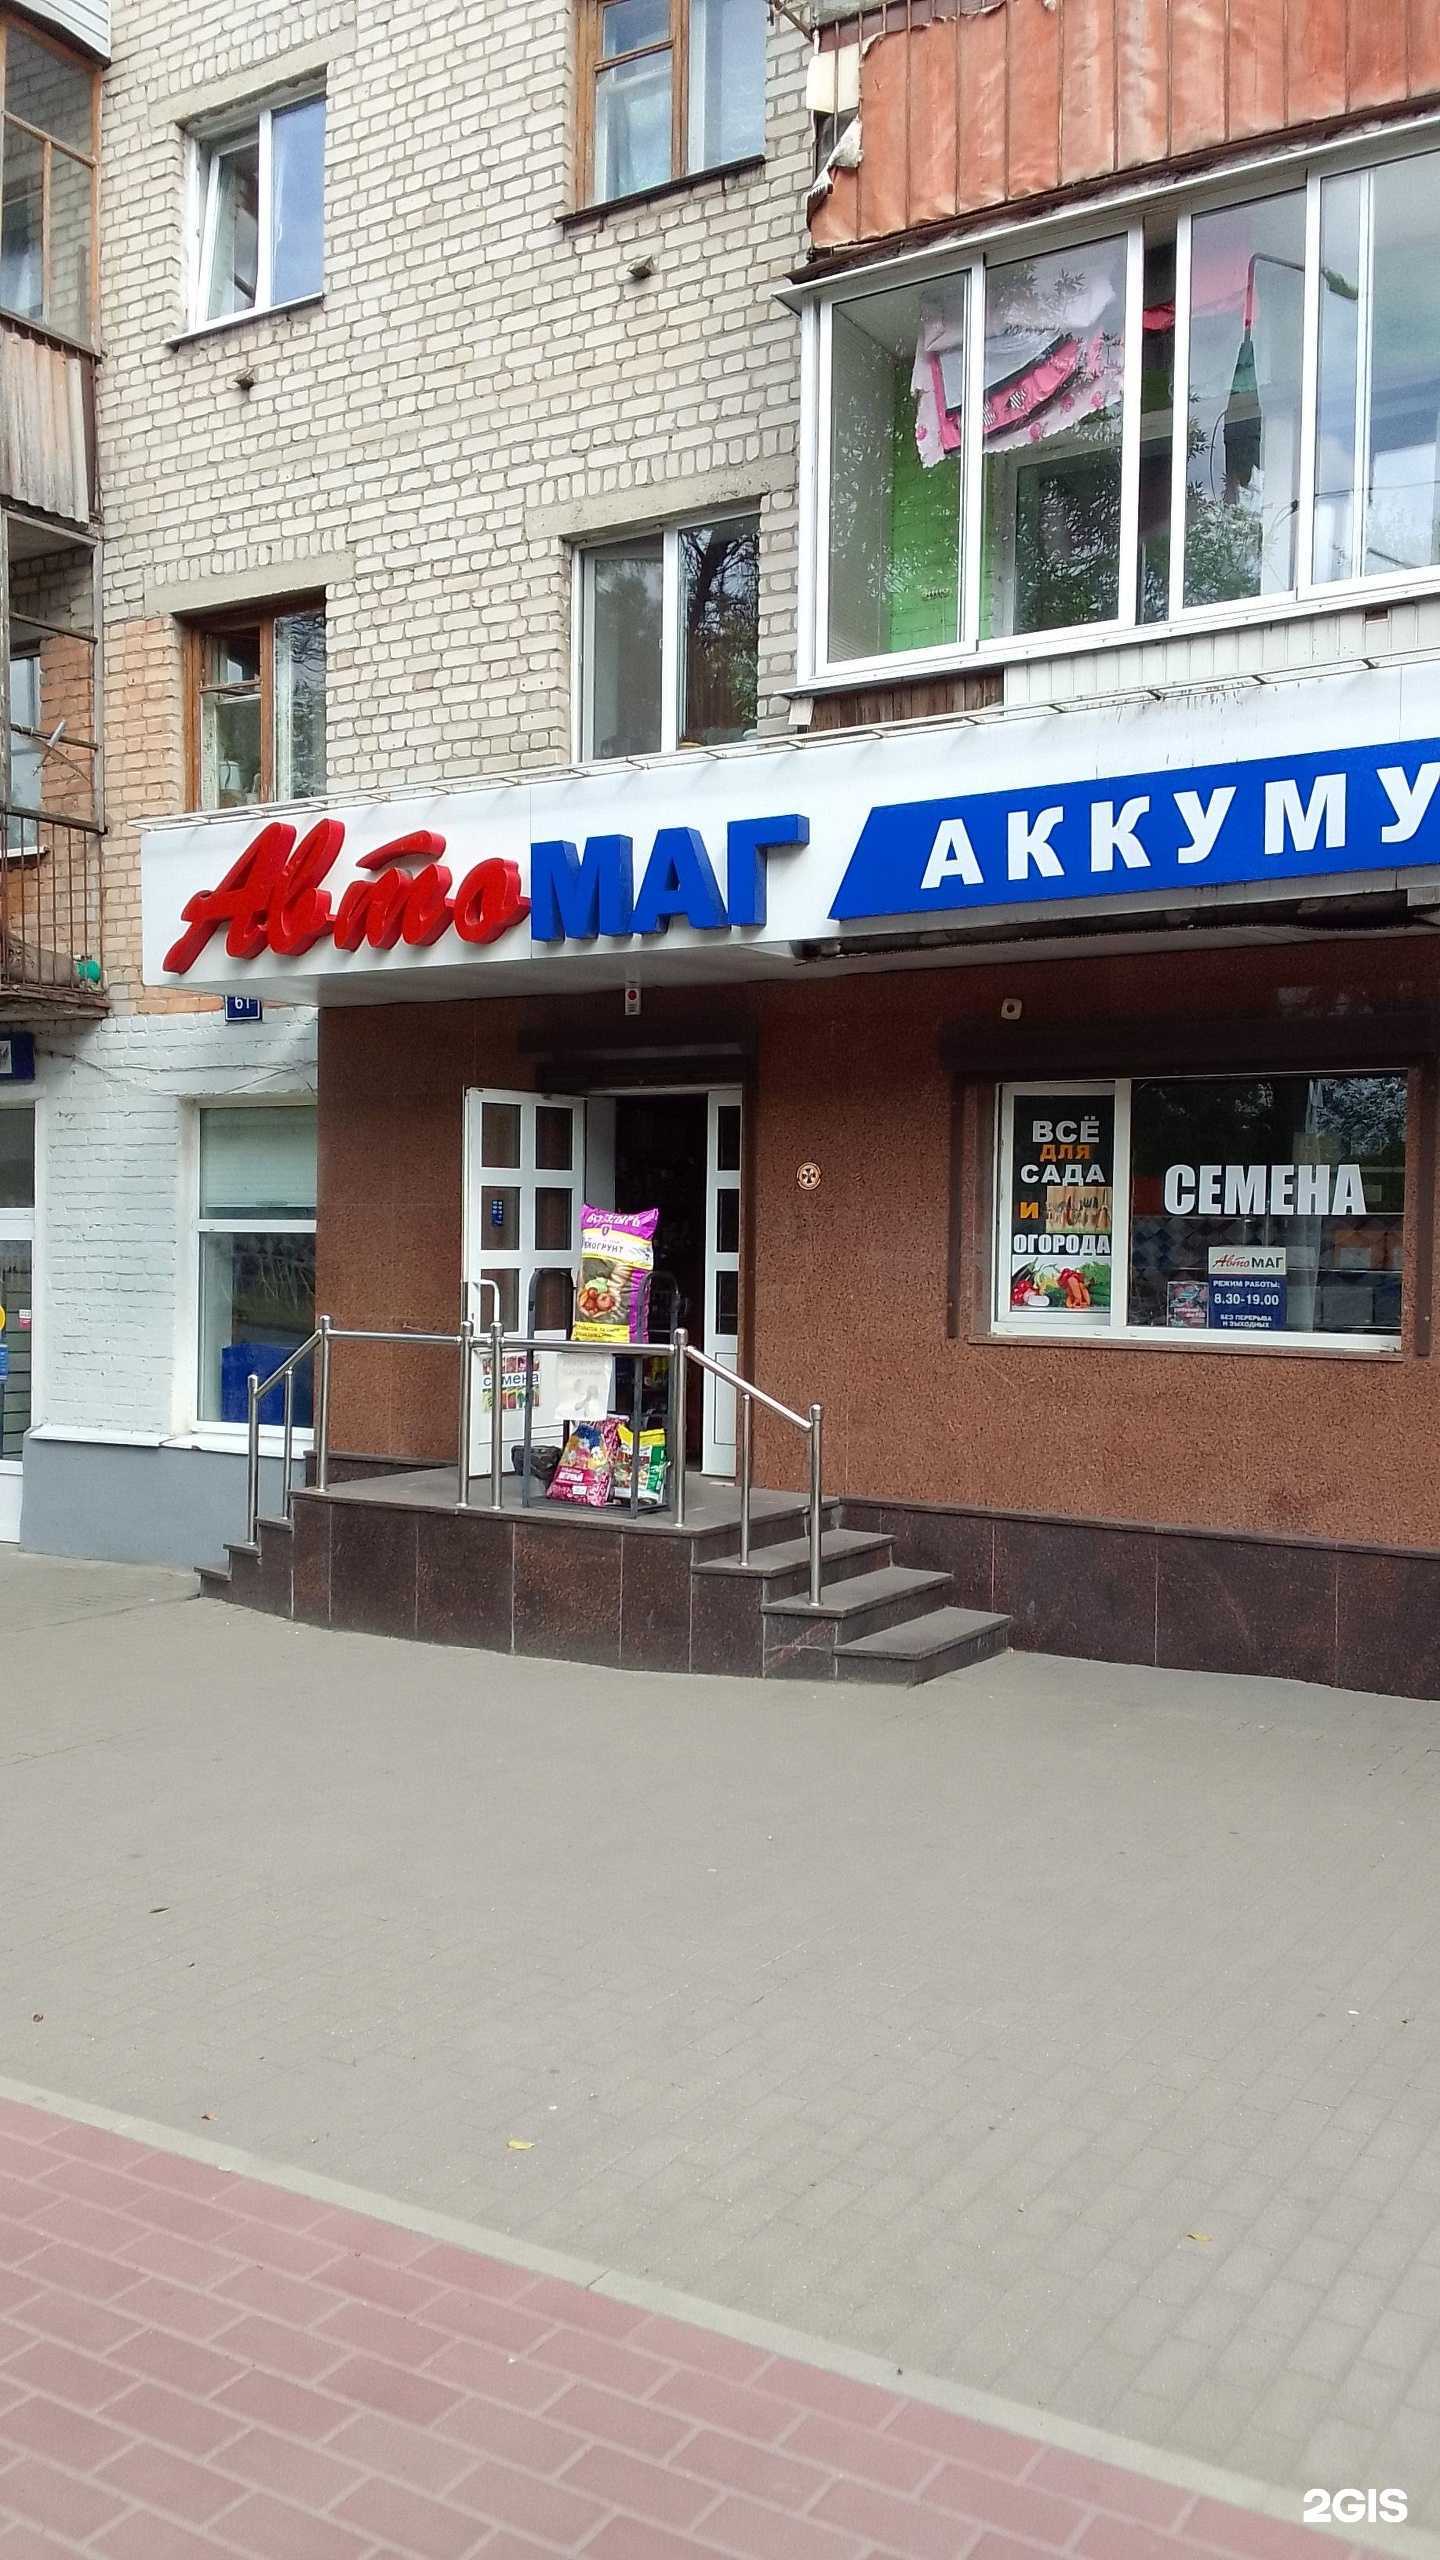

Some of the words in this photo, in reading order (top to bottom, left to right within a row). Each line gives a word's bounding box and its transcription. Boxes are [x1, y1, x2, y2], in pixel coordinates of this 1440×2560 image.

[920, 762, 1440, 889] АККУМУ
[1032, 1116, 1100, 1143] ВСЁ
[1039, 1144, 1090, 1162] ДЛЯ
[1020, 1164, 1105, 1186] САДА
[1164, 1163, 1367, 1216] СЕМЕНА
[1019, 1201, 1039, 1219] И
[1013, 1233, 1111, 1256] ОГОРОДА
[1213, 1280, 1243, 1288] РЕЖИМ
[1244, 1280, 1280, 1289] РАБОТЫ:
[1214, 1293, 1279, 1306] 8.30-19.00
[483, 1373, 539, 1387] смена
